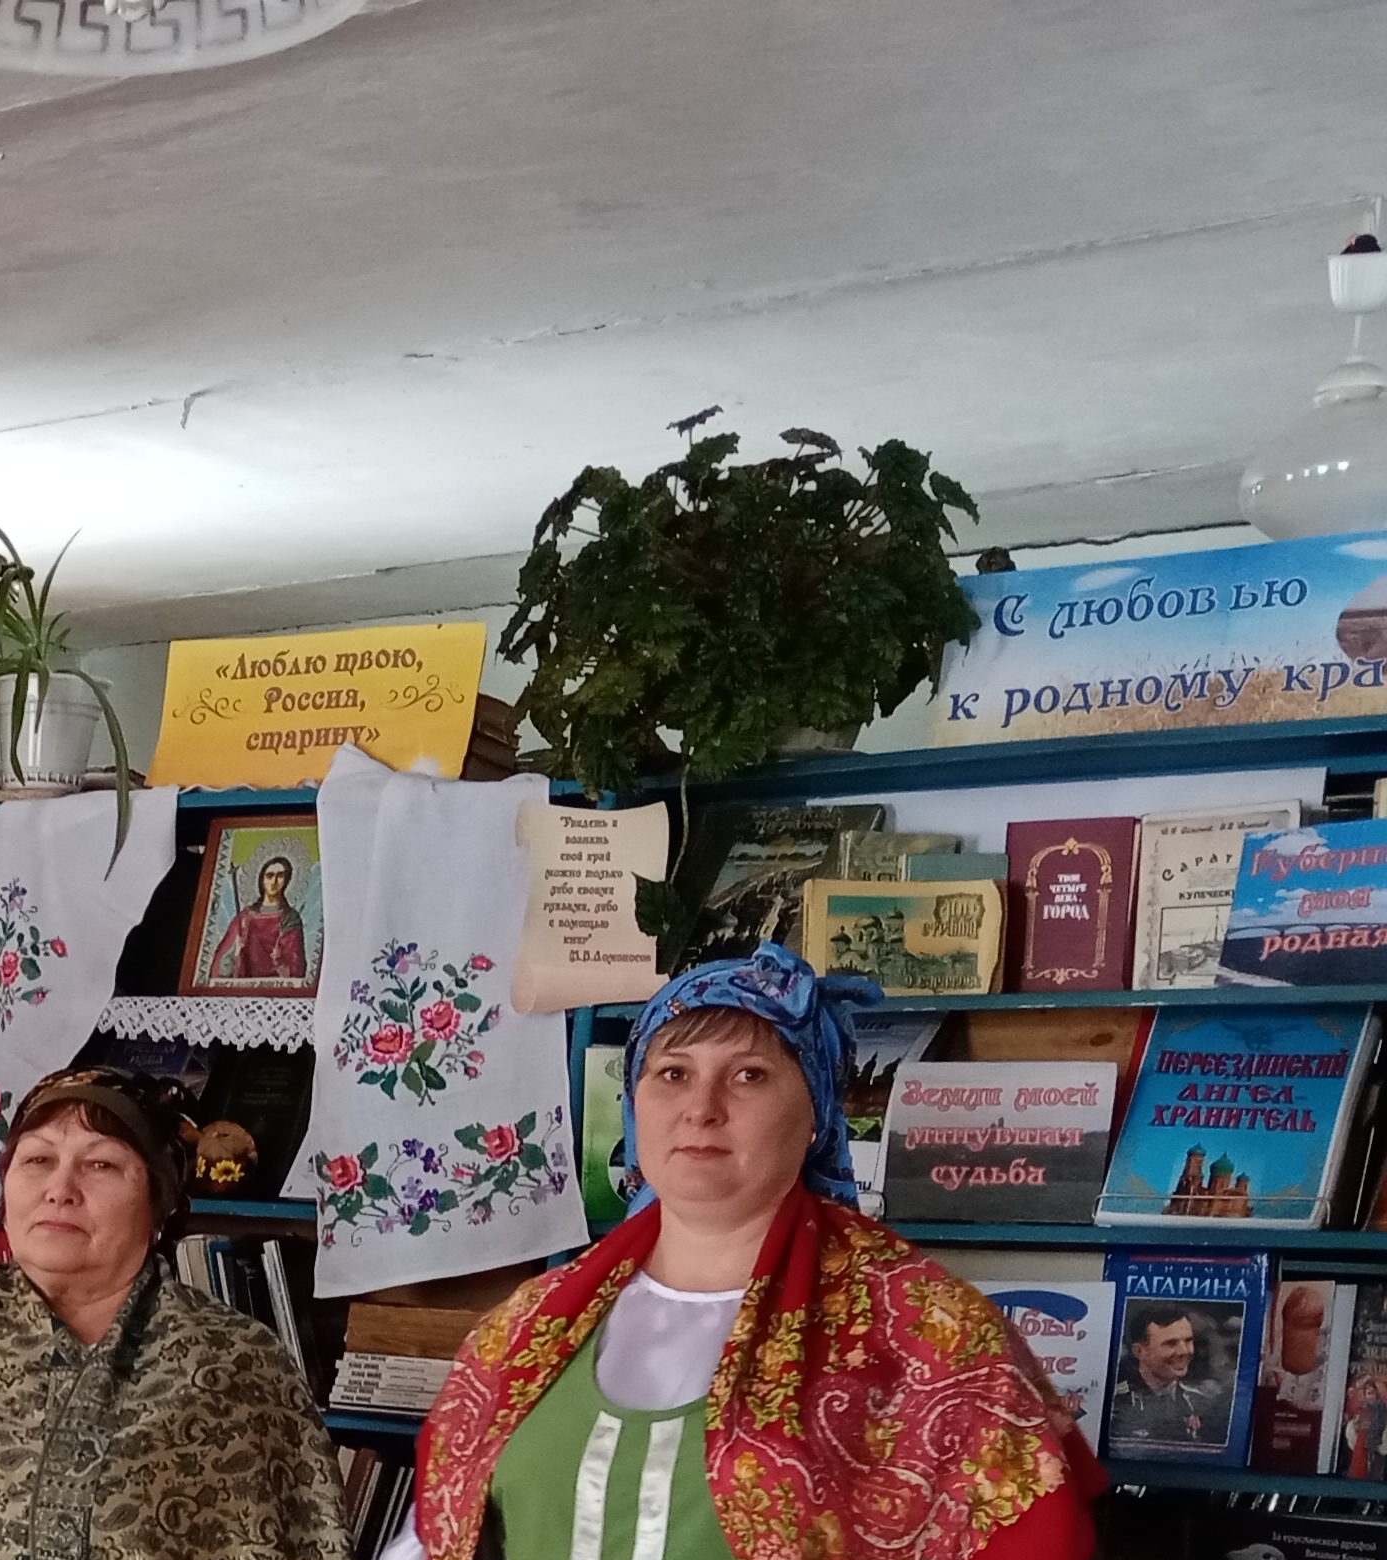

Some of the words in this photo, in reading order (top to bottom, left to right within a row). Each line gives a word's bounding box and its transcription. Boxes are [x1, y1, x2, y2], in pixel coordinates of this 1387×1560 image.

[993, 592, 1029, 637] С
[215, 650, 327, 681] «Люблю
[333, 647, 424, 676] твою,
[262, 686, 367, 714] Россия,
[947, 692, 980, 722] к
[1000, 666, 1256, 728] родному
[1281, 657, 1387, 701] кра
[245, 725, 381, 756] старину»
[611, 819, 618, 828] и
[560, 851, 583, 862] свой
[587, 851, 611, 864] край
[545, 868, 582, 880] можно
[584, 869, 623, 880] только
[550, 881, 574, 897] либо
[577, 885, 614, 898] своими
[1298, 888, 1373, 917] моя
[543, 901, 591, 914] руками,
[594, 899, 619, 914] либо
[1042, 904, 1090, 922] ГОРОД
[558, 918, 609, 931] помощью
[1258, 926, 1387, 962] родная
[1155, 1047, 1348, 1085] ПЕРЕЕЗДИНСКИЙ
[901, 1079, 1003, 1112] Земли
[1014, 1081, 1099, 1112] моей
[1148, 1104, 1317, 1134] ХРАНИТЕЛЬ
[905, 1125, 1084, 1153] минувшая
[929, 1156, 1047, 1191] судьба
[1125, 1275, 1249, 1298] ГАГАРИНА
